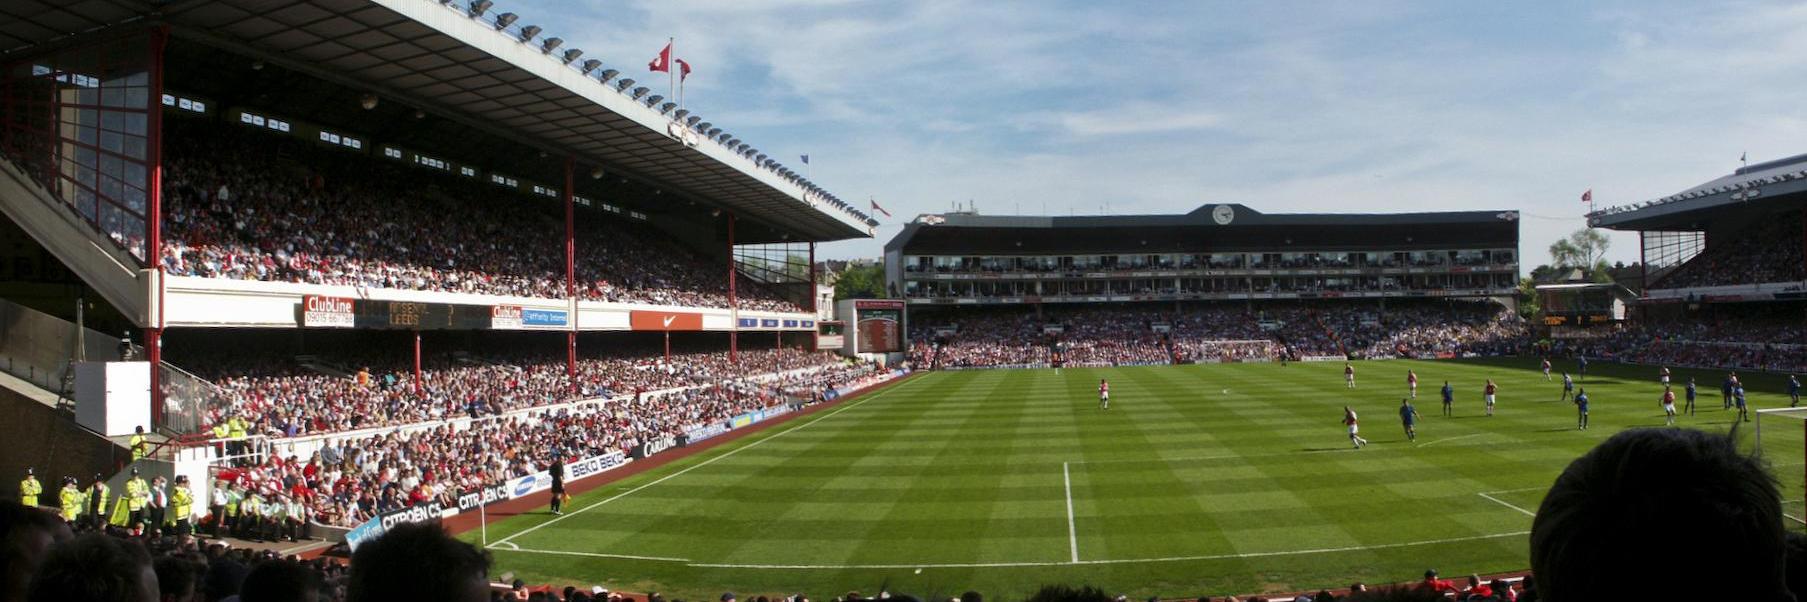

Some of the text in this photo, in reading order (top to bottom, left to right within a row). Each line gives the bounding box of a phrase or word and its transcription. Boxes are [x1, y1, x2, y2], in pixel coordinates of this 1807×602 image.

[308, 296, 352, 313] ClubLine
[643, 435, 677, 458] CARLING
[571, 452, 624, 477] BEKO BEKO
